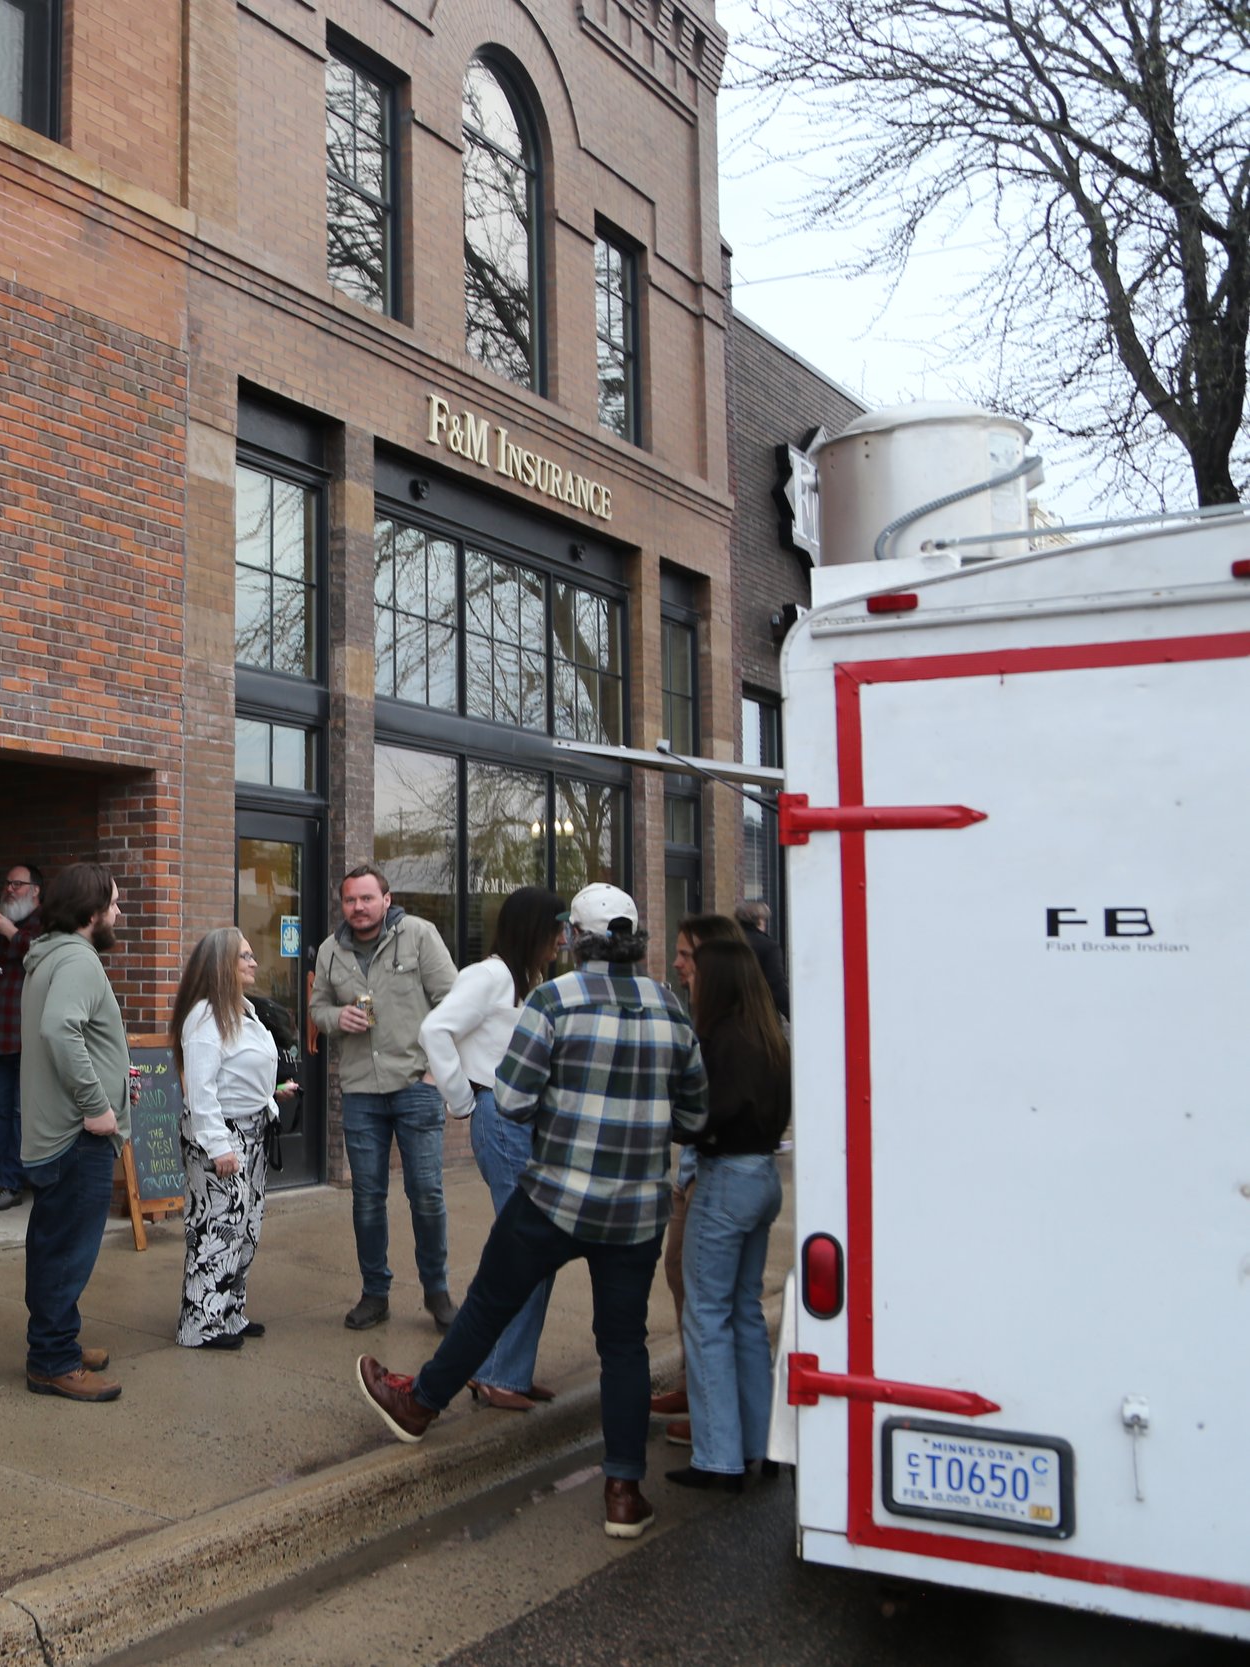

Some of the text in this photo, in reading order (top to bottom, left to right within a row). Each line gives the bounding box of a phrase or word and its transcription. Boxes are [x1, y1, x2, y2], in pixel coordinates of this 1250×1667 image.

[425, 393, 613, 521] F&M INSURANCE
[1046, 941, 1190, 953] Flat Broke Indian
[147, 1137, 173, 1157] YES!
[150, 1158, 179, 1175] HOUSE
[932, 1441, 1014, 1461] MINNESOTA
[926, 1454, 1030, 1502] T0650
[976, 1498, 1018, 1514] LAKES
